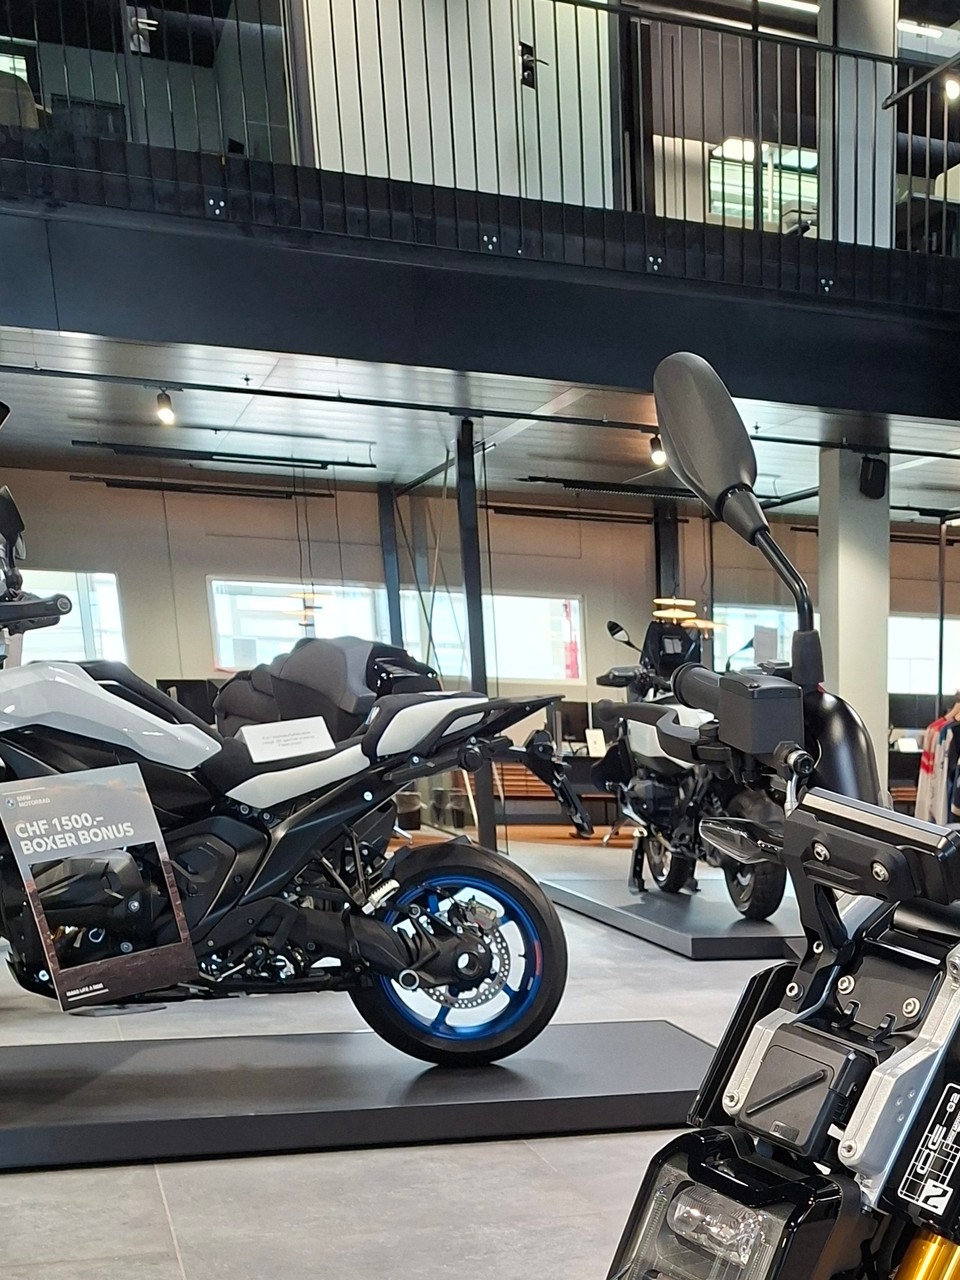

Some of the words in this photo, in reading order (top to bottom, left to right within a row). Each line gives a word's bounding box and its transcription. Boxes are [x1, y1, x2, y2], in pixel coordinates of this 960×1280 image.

[19, 798, 50, 807] MOTORRAD
[15, 819, 48, 837] CHF
[20, 833, 78, 854] BOXER
[78, 822, 134, 844] BONUS
